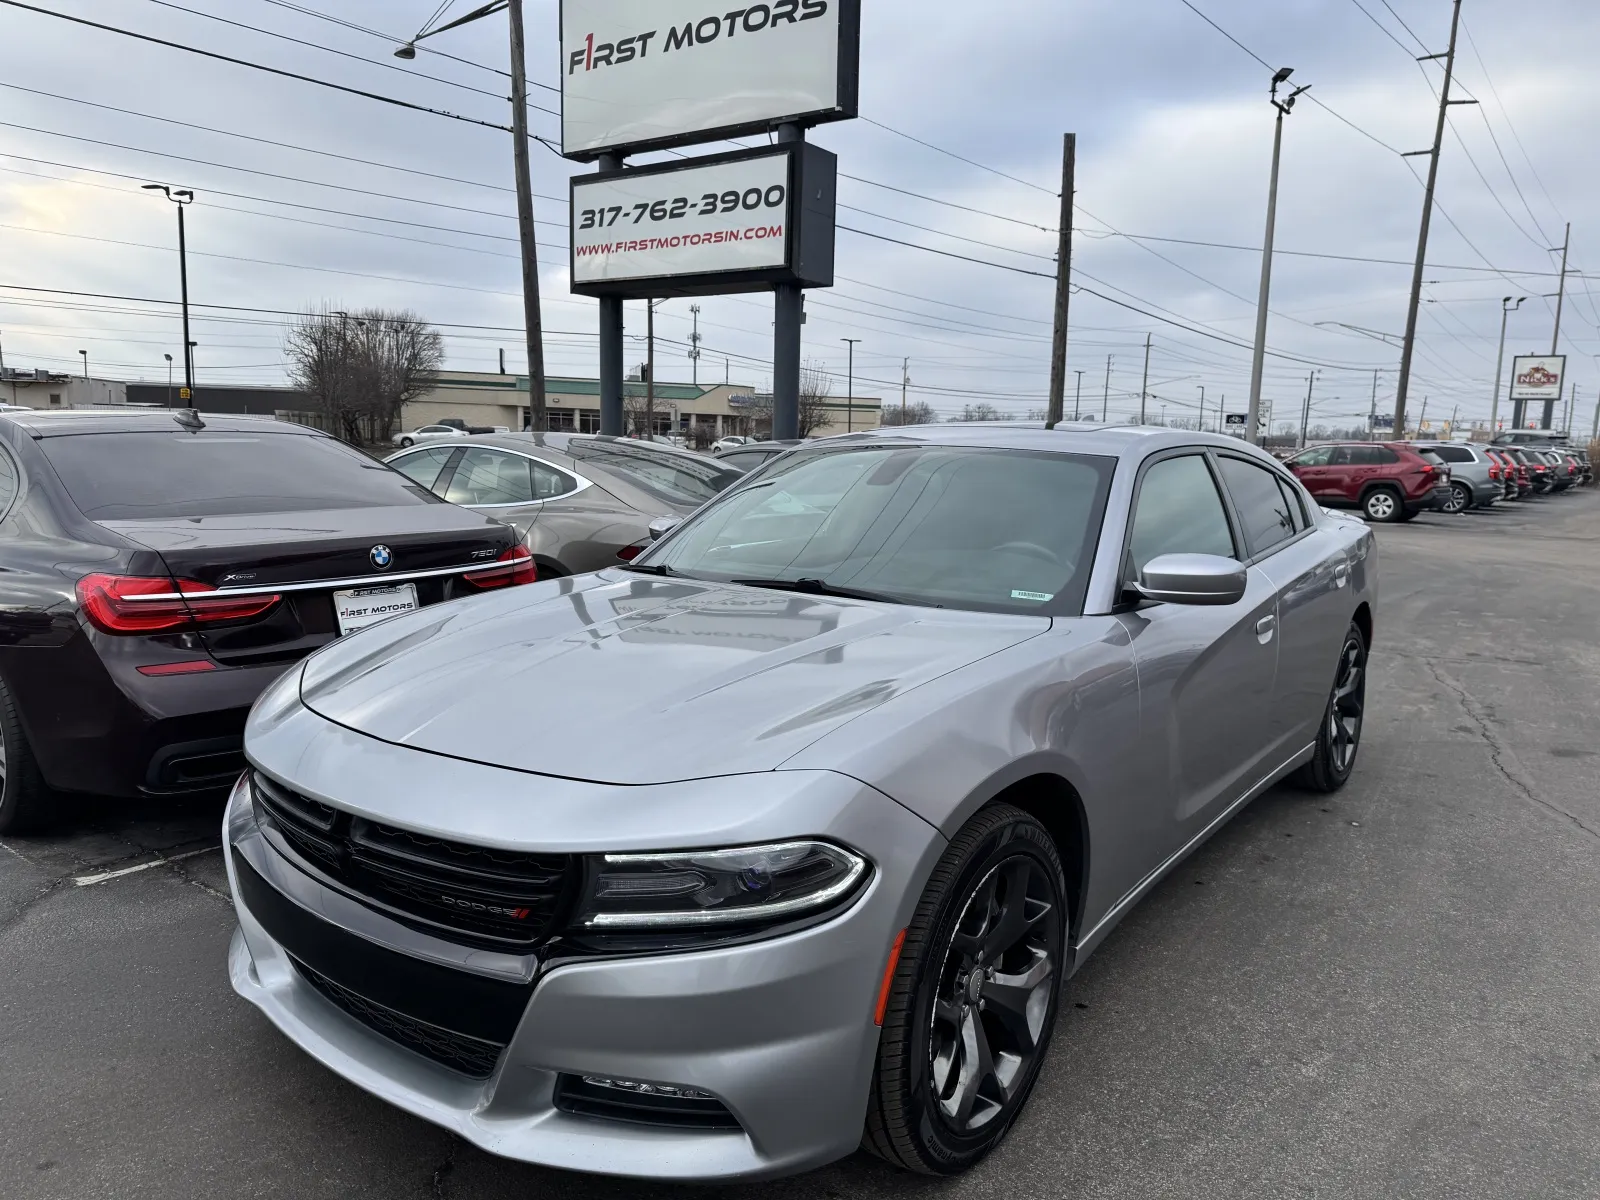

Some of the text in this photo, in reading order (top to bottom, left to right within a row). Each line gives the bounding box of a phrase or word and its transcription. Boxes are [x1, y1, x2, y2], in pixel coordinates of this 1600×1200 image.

[663, 0, 828, 53] MOTORS
[579, 185, 785, 230] 317-762-3900
[576, 225, 783, 257] WWW.FIRSTMOTORSIN.COM
[371, 602, 413, 614] MOTORS
[441, 895, 519, 917] DODGE
